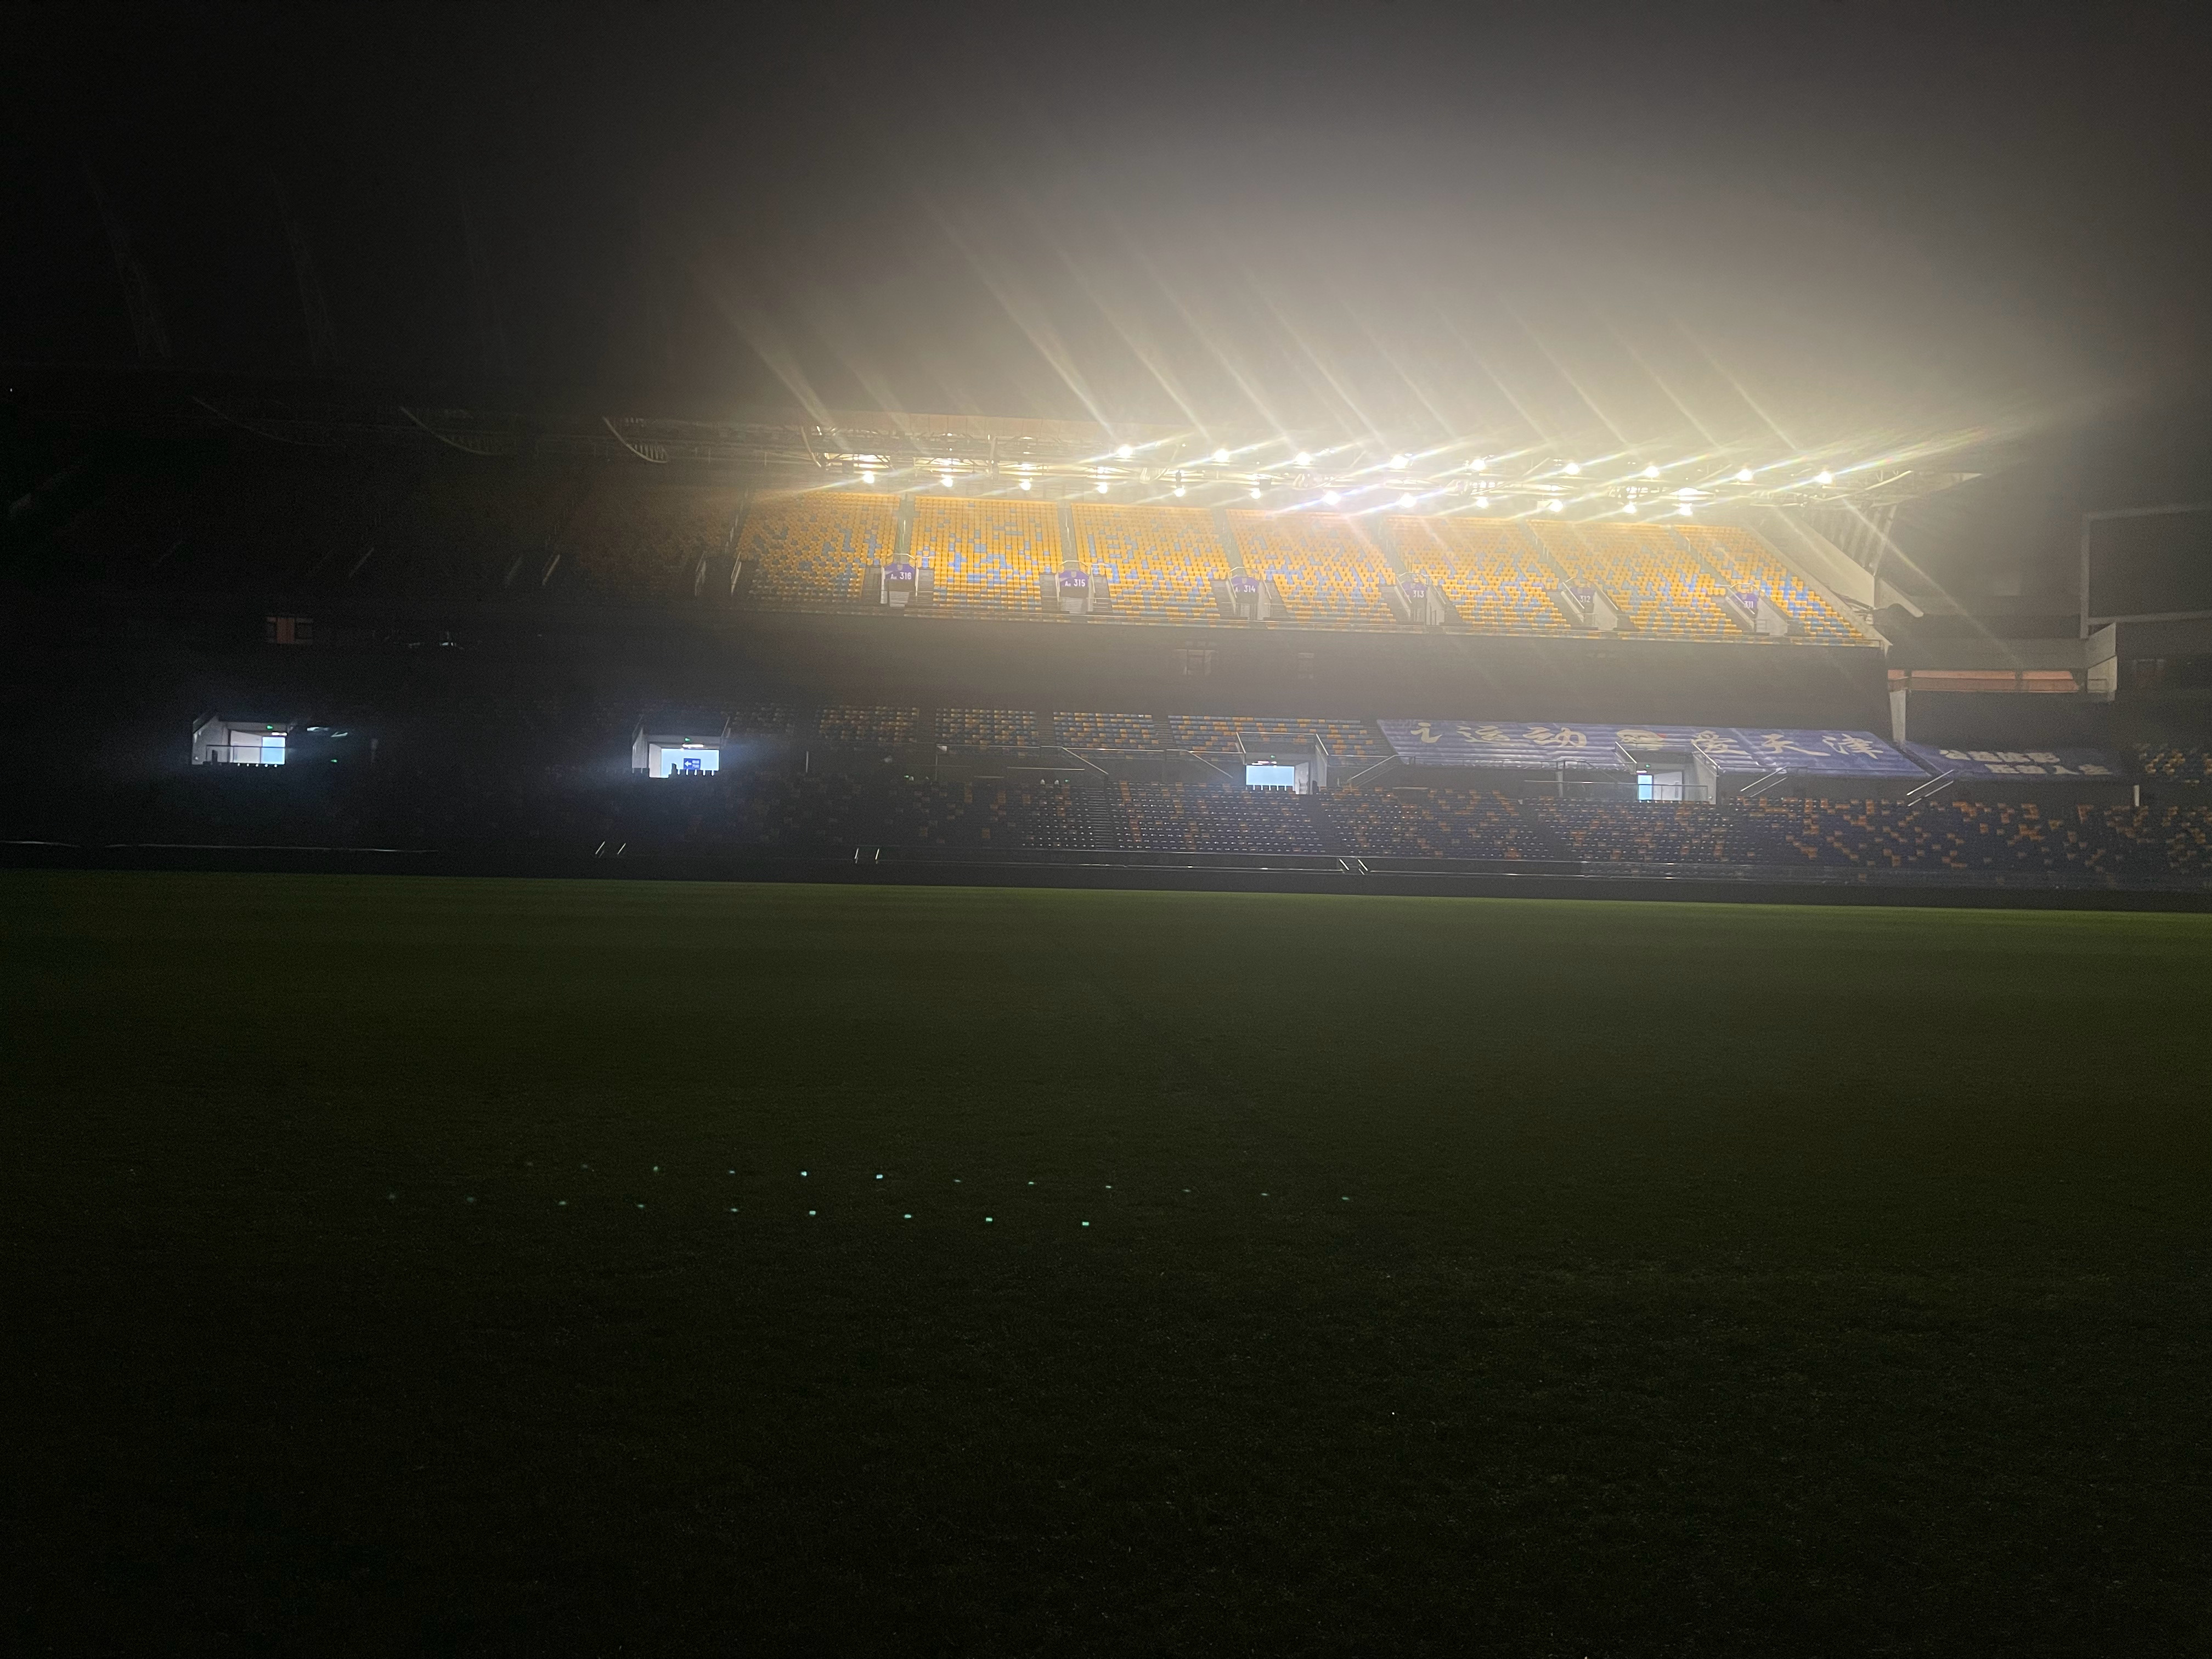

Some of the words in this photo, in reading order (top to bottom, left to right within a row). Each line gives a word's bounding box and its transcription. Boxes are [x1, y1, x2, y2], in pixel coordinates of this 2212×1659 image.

[899, 572, 912, 580] 316
[1073, 579, 1086, 587] 315
[1413, 590, 1425, 598] 313
